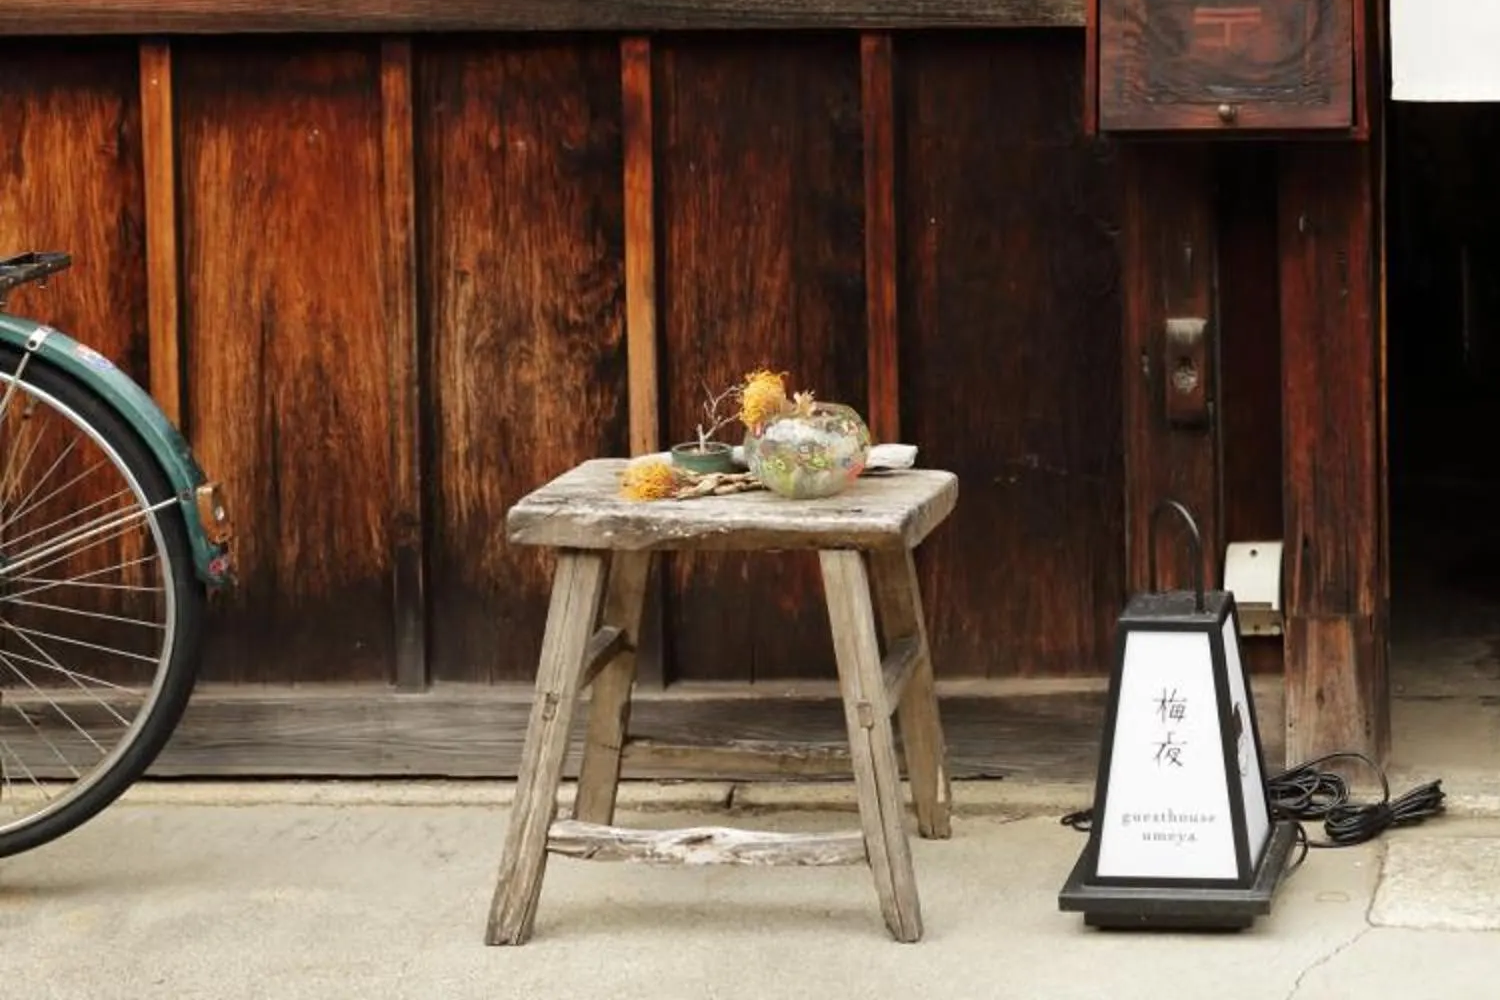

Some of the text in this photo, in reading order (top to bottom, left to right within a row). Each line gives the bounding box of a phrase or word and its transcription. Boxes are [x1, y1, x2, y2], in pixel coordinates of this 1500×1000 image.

[1152, 687, 1188, 768] 梅夜
[1121, 808, 1216, 826] guesthouse
[1142, 830, 1197, 848] umeya
